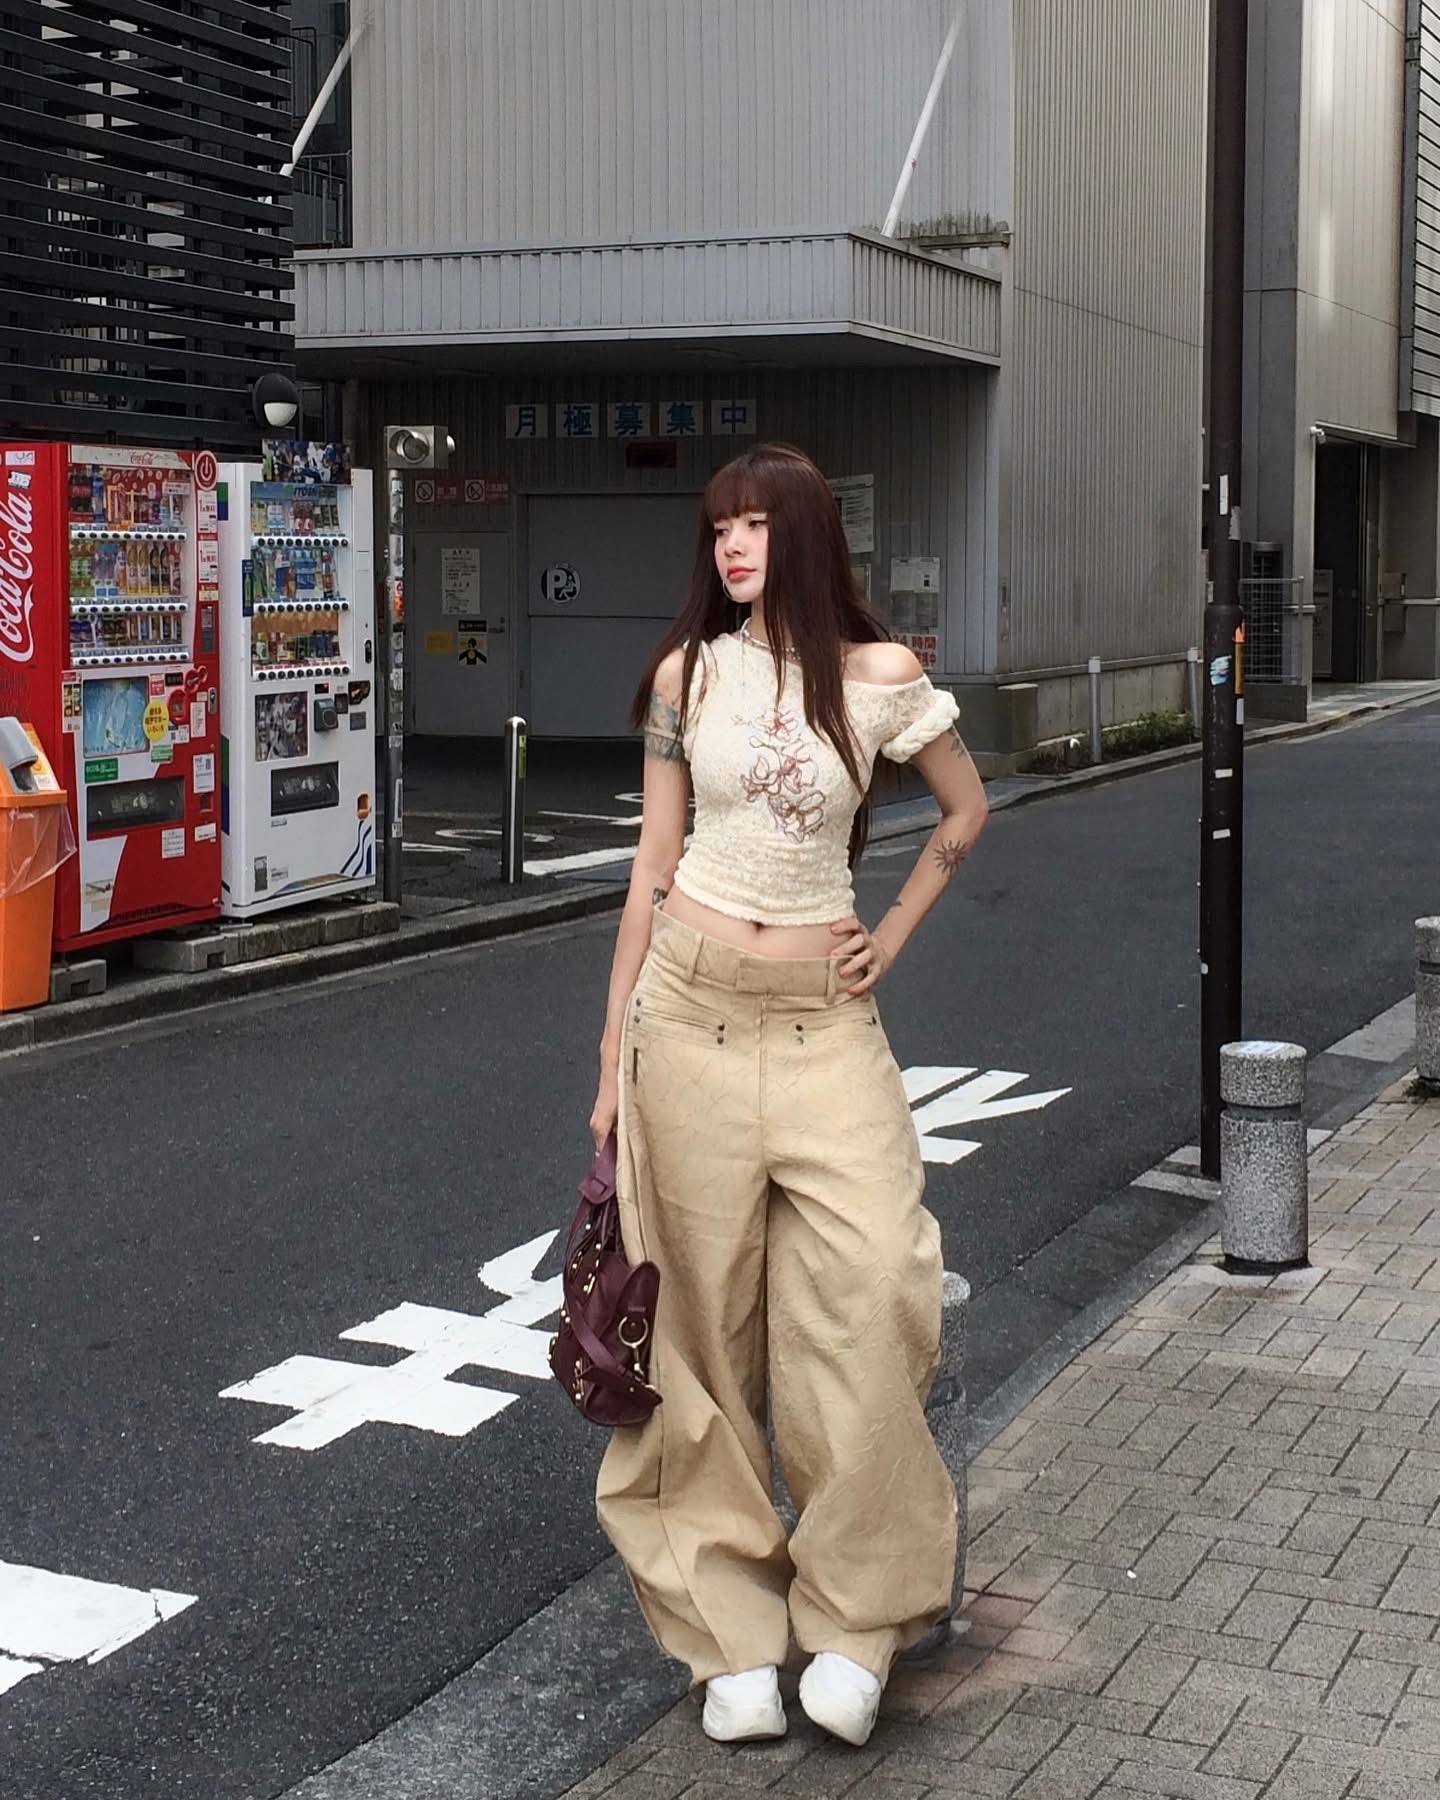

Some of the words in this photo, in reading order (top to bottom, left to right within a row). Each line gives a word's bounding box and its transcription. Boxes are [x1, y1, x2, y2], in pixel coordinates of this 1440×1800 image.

[514, 401, 747, 437] 月極募集中
